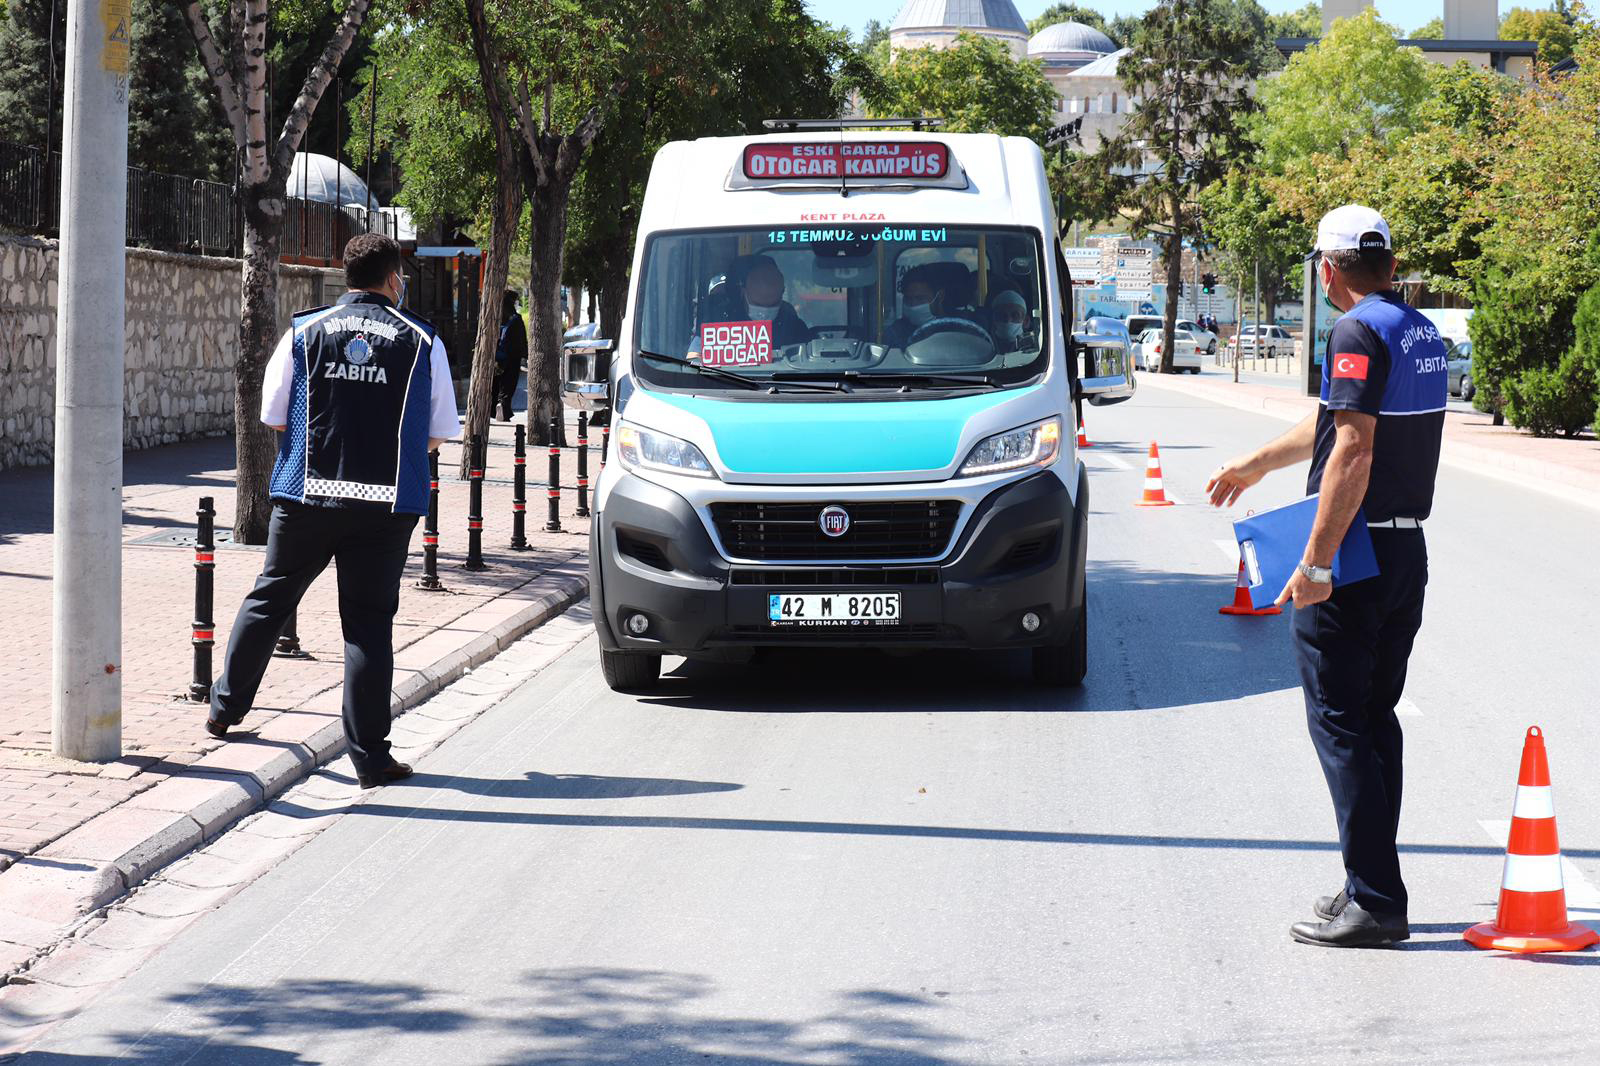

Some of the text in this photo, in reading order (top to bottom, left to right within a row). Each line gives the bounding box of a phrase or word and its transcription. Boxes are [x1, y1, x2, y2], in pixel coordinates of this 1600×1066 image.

[842, 145, 900, 156] GARAJ
[751, 150, 941, 175] OTOGAR KAMPÜS
[800, 213, 886, 221] KENT PLAZA
[768, 231, 786, 243] 15
[921, 227, 947, 242] EVİ
[323, 315, 399, 342] BÜYÜKŞEHİR
[703, 325, 771, 346] BOSNA
[702, 343, 769, 364] OTOGAR
[323, 361, 388, 385] ZABITA
[1415, 355, 1448, 374] ZABITA
[826, 515, 843, 529] FIAT
[781, 596, 896, 617] 42 M 8205
